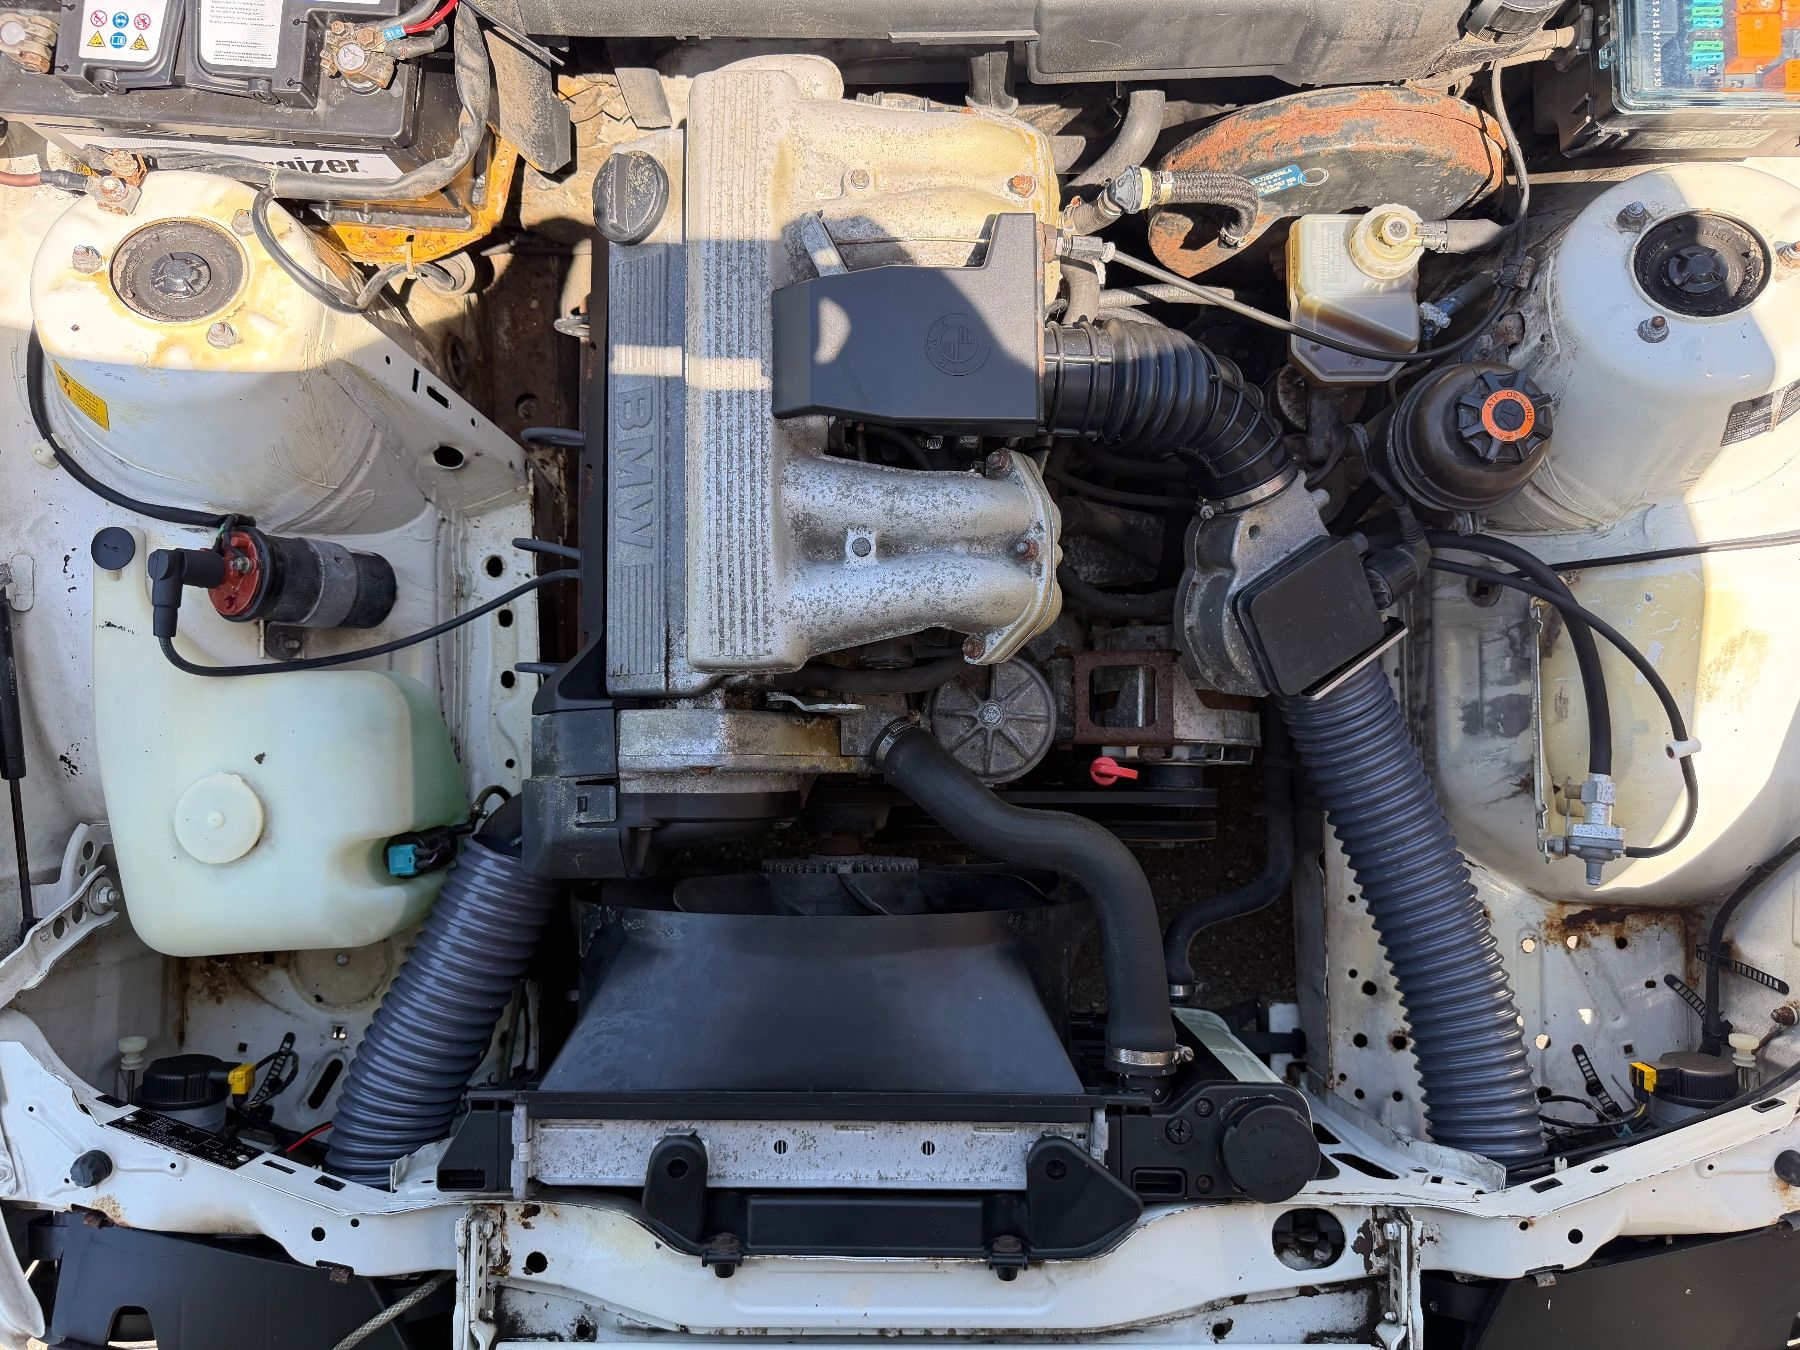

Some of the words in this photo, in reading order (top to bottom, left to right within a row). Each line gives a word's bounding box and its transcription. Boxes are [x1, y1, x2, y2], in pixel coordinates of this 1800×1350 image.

[1652, 8, 1660, 17] 24
[1652, 19, 1660, 28] 25
[1652, 31, 1660, 40] 26
[1653, 43, 1661, 52] 27
[1653, 53, 1661, 62] 28
[1654, 67, 1662, 76] 29
[1707, 64, 1715, 74] K8
[1654, 78, 1662, 87] 30
[1487, 393, 1499, 408] ATF
[1523, 401, 1533, 424] ONLY
[617, 386, 653, 548] BMW
